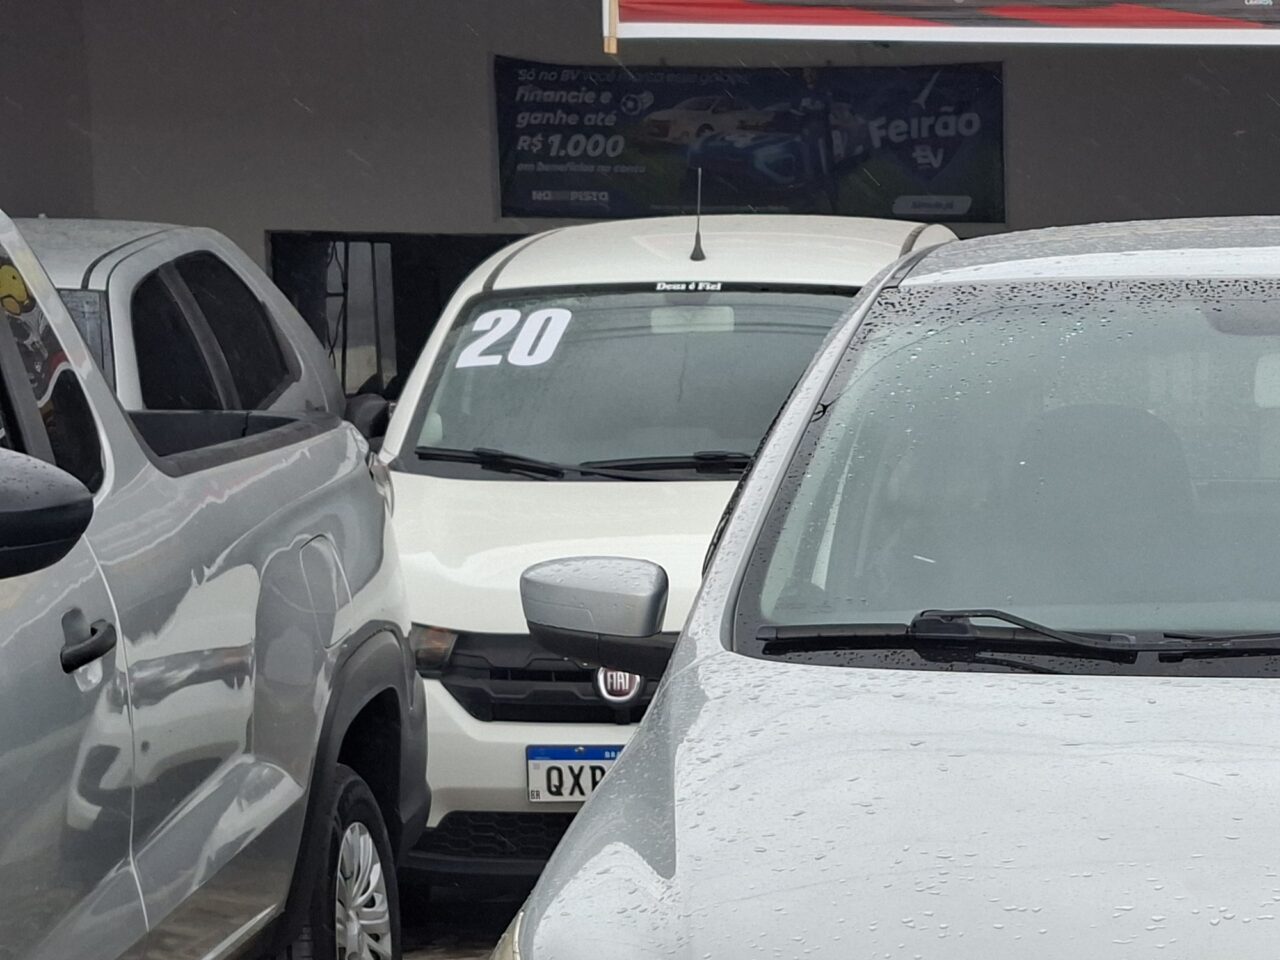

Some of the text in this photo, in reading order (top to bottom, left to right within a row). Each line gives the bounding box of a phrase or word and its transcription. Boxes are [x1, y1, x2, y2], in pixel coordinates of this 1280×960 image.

[539, 70, 558, 82] no
[560, 69, 580, 82] BV
[600, 90, 613, 104] e
[516, 110, 617, 129] ganhe até
[868, 105, 982, 149] Feirão
[516, 133, 625, 158] R$ 1.000
[655, 281, 722, 292] Deus é Fiel
[455, 307, 572, 369] 20
[606, 671, 630, 691] FIAT
